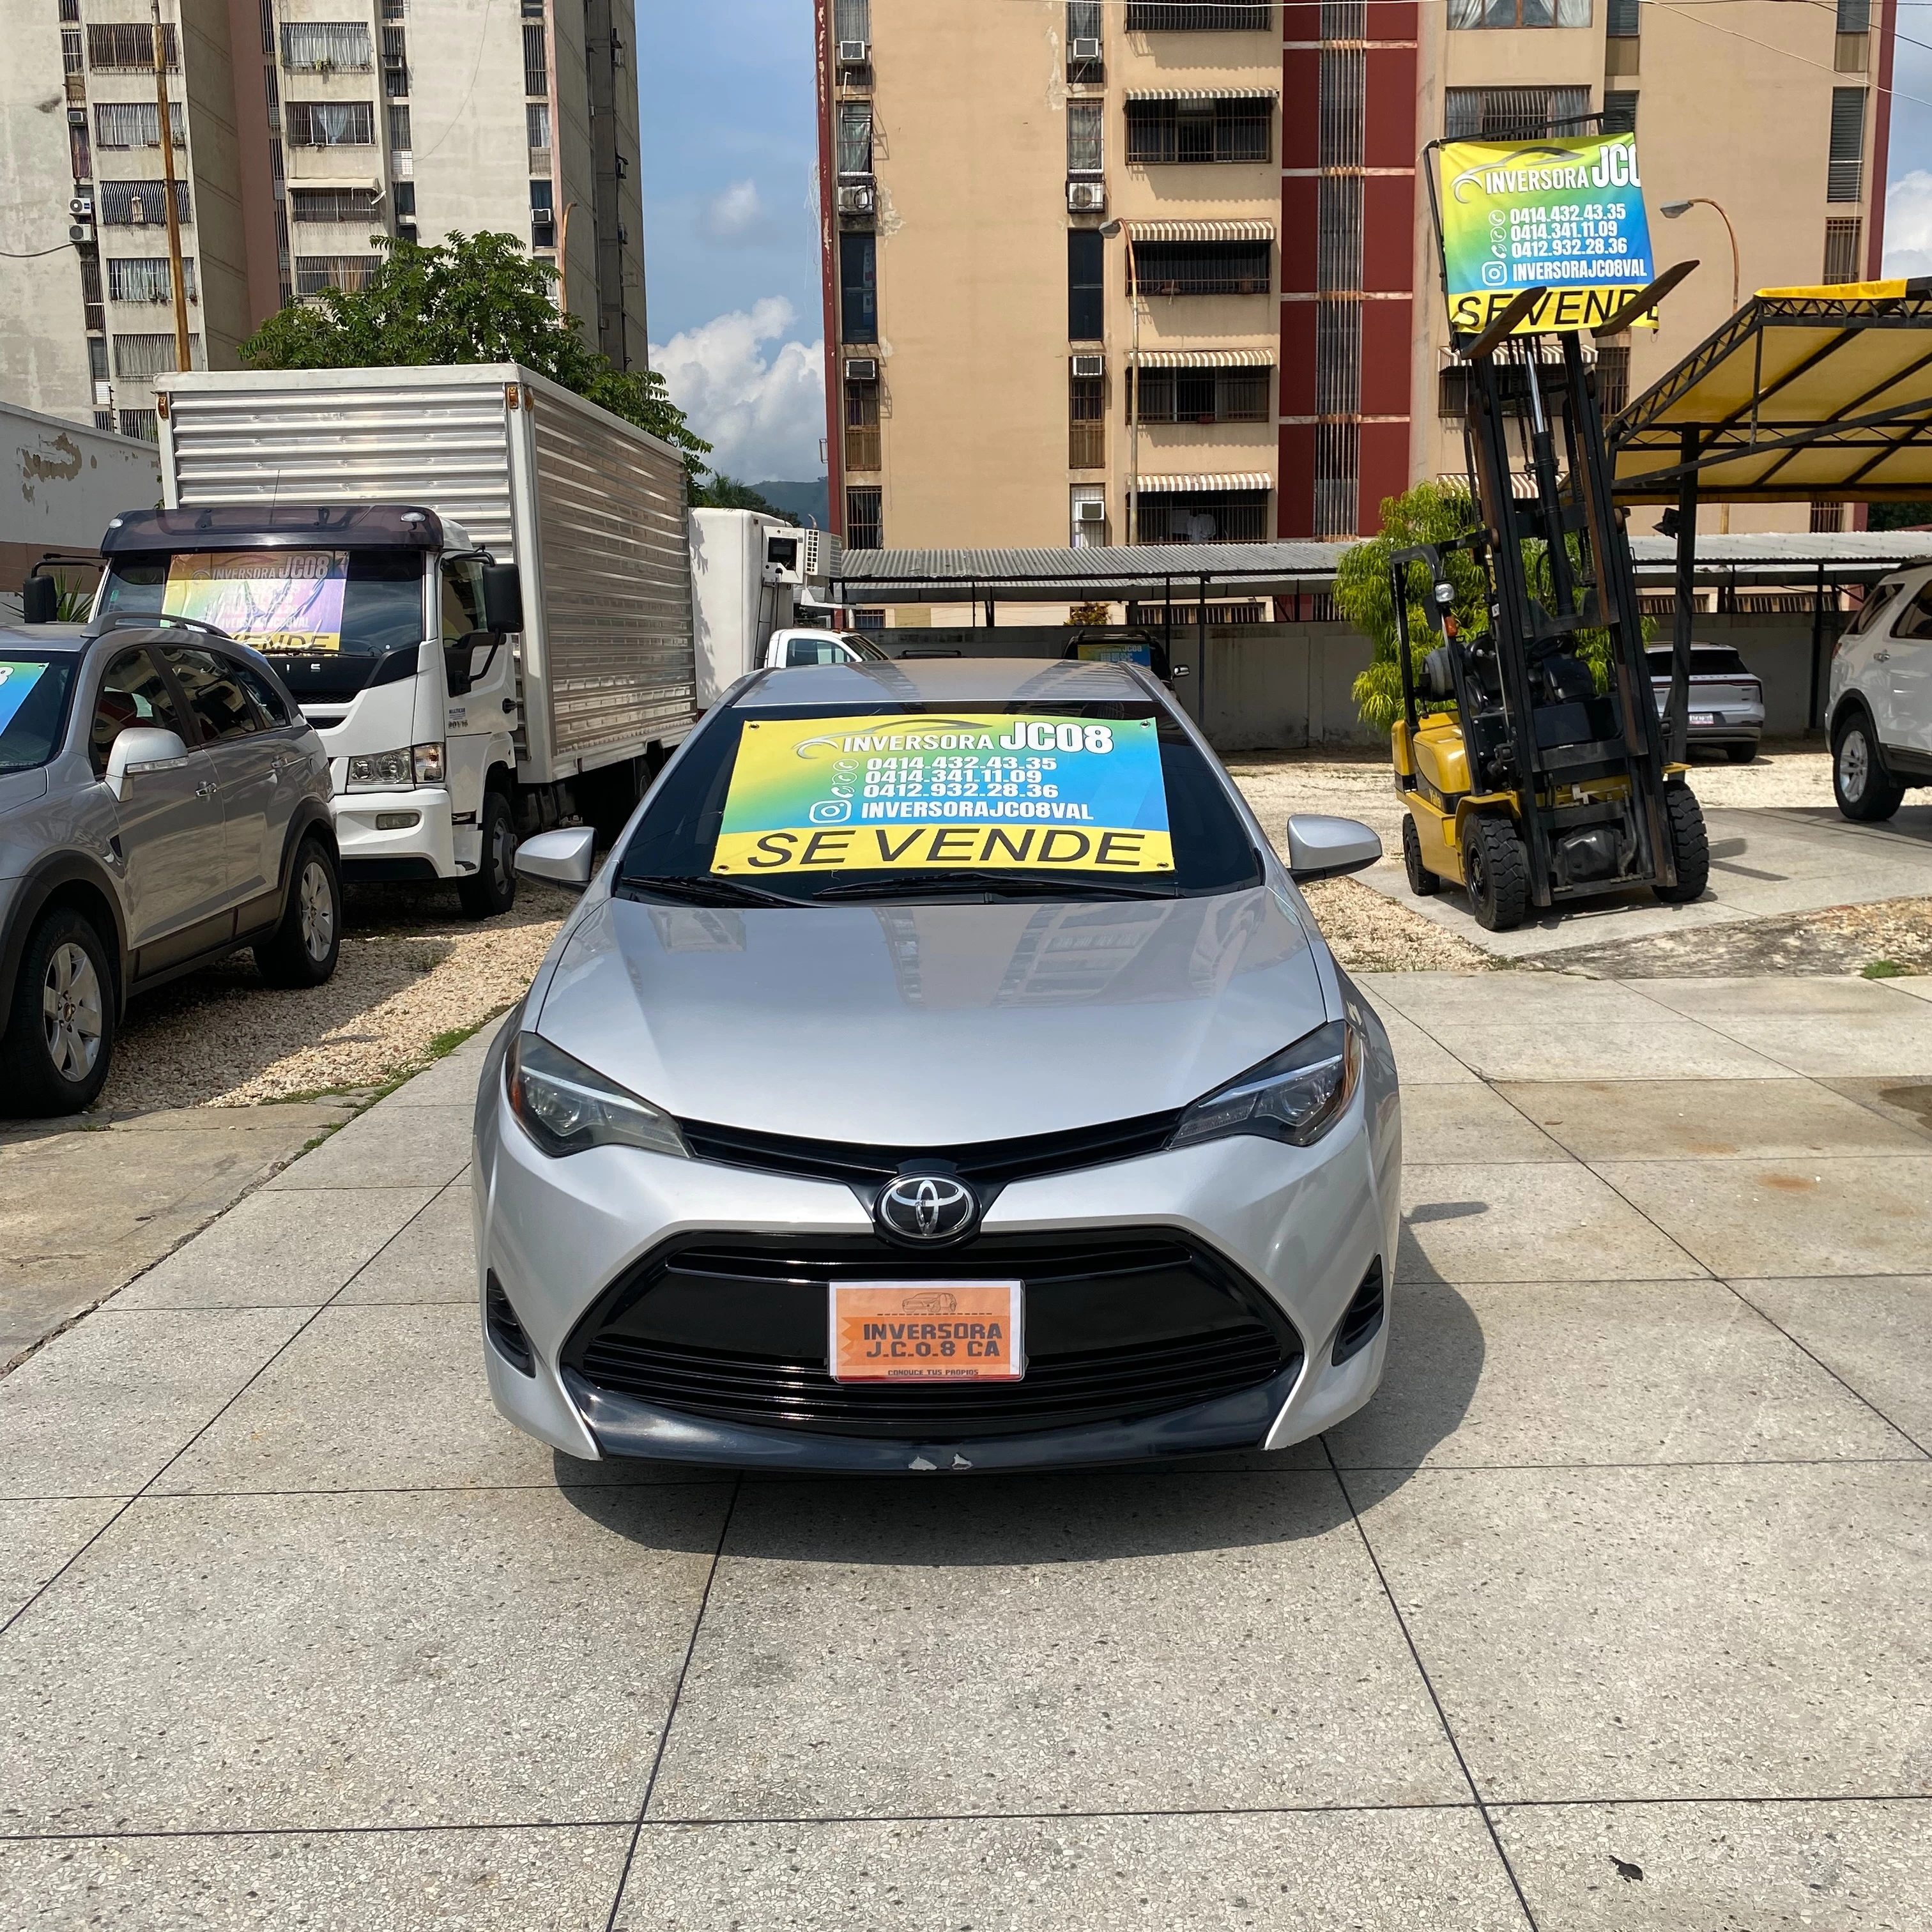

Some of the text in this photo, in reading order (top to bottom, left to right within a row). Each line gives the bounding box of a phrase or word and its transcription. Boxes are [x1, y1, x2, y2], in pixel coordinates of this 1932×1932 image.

[1485, 165, 1590, 194] INVERSORA
[1510, 203, 1627, 224] 0414.432.43.35
[1510, 220, 1618, 241] 0414.341.11.09
[1511, 237, 1628, 259] 0412.932.28.36
[213, 567, 276, 580] INVERSORA
[843, 734, 995, 753] INVERSORA
[866, 756, 1058, 770] 0414.432.43.35
[864, 769, 1043, 784] 0414.341.11.09
[862, 783, 1060, 798] 0412.932.28.36
[747, 829, 1146, 868] SE VENDE
[864, 1323, 1002, 1340] INVERSORA
[967, 1340, 1000, 1357] CA
